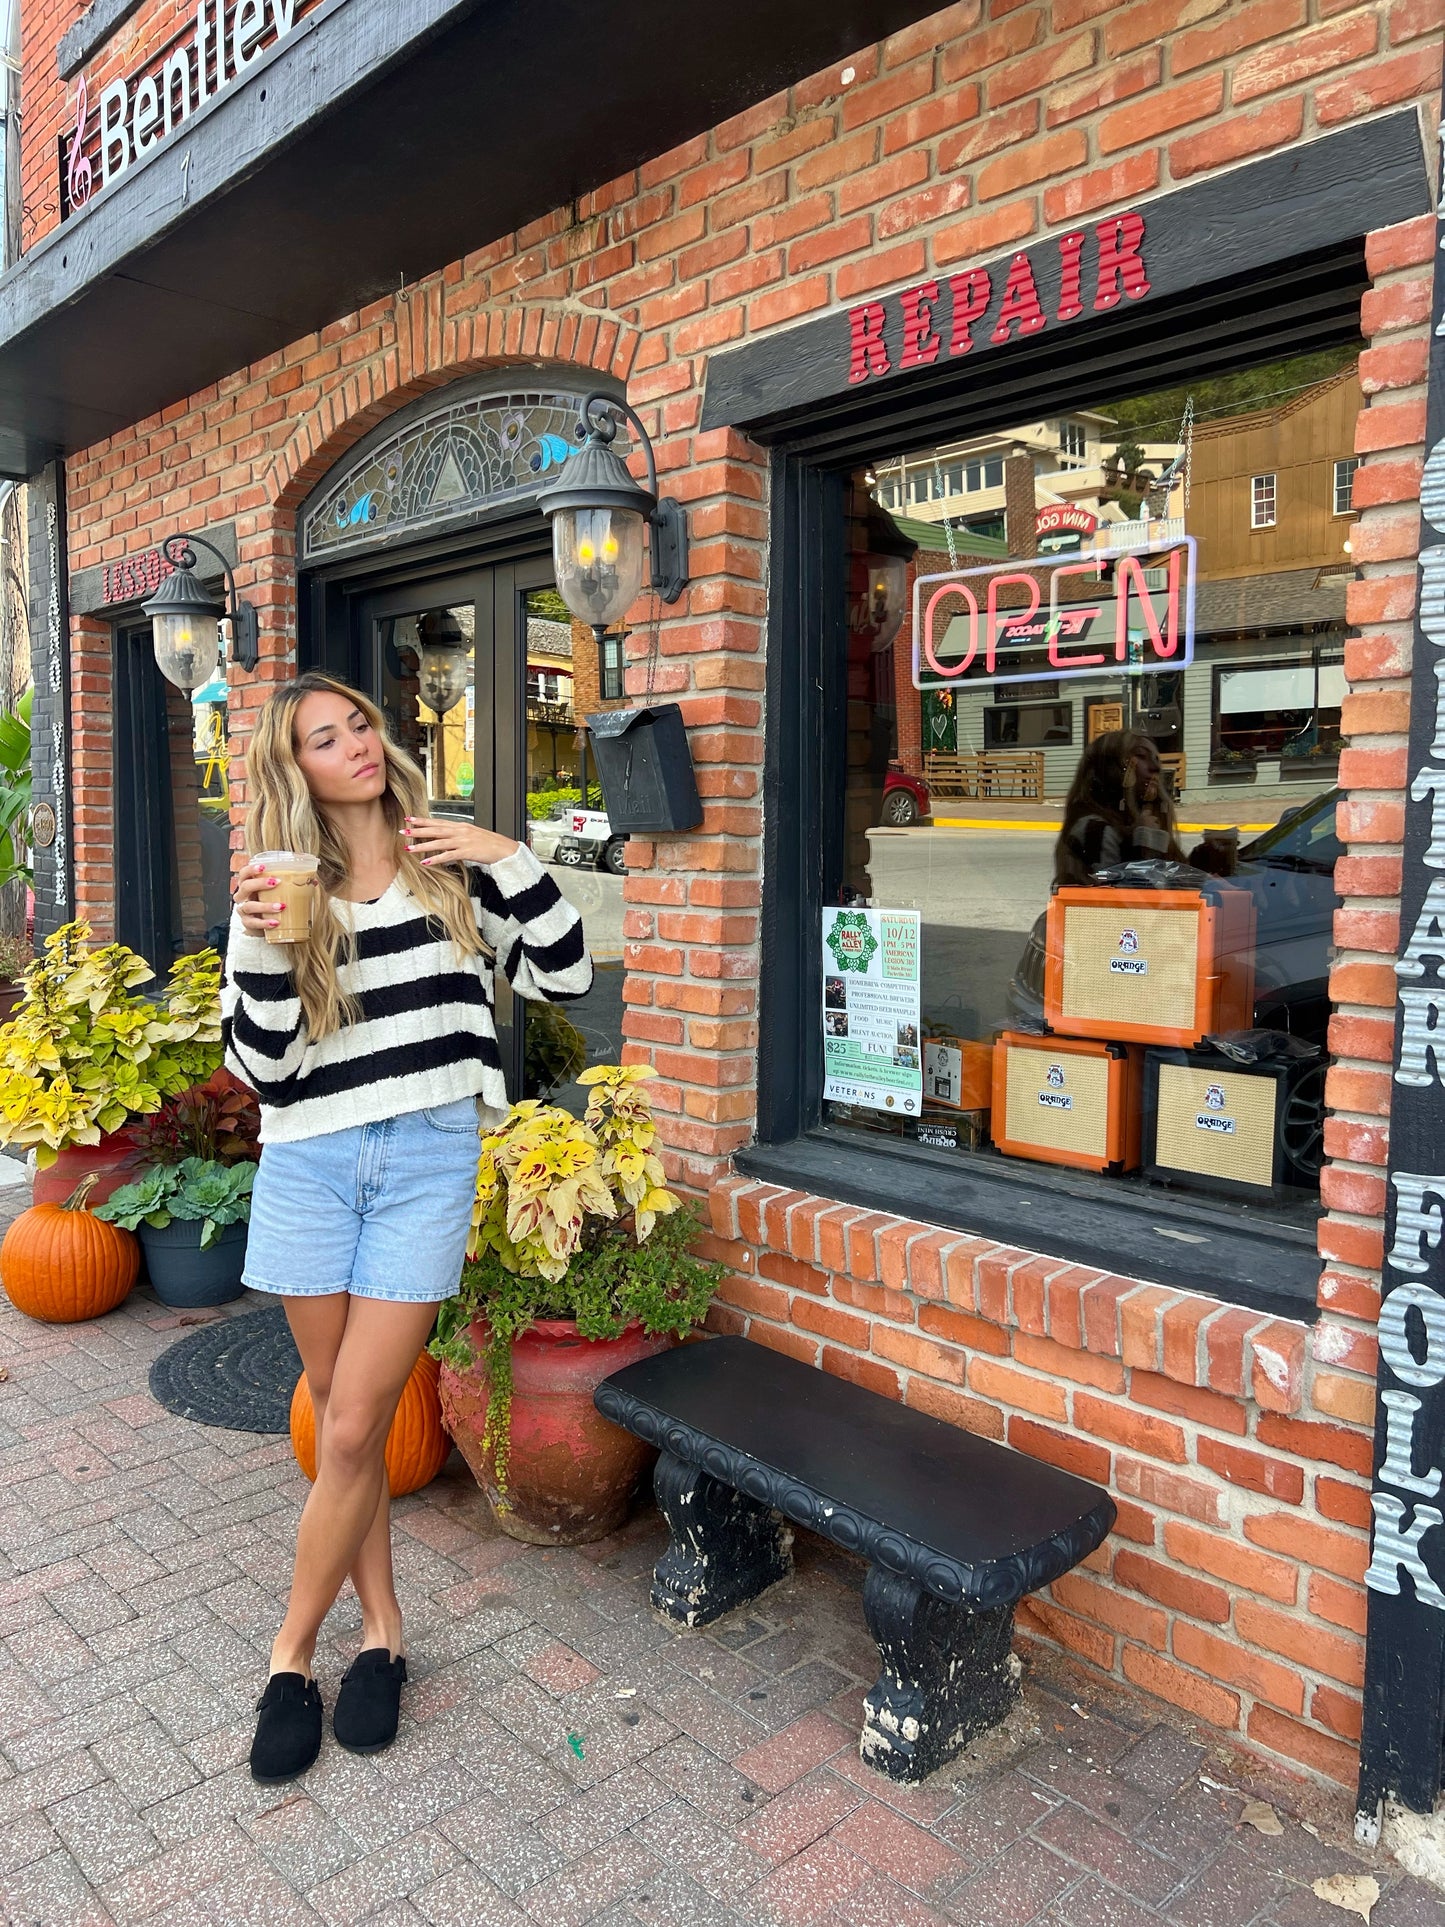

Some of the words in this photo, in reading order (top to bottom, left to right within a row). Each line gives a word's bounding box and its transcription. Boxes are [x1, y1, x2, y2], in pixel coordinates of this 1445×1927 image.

[848, 211, 1151, 385] REPAIR
[46, 502, 61, 692] PIANO
[924, 550, 1181, 677] OPEN
[52, 721, 66, 906] VOICE
[881, 915, 915, 924] SATURDAY
[841, 930, 862, 940] RALLY
[887, 926, 915, 941] 10/12
[842, 940, 862, 948] ALLEY
[886, 949, 914, 958] AMERICAN
[884, 957, 904, 965] LEGION
[1112, 961, 1145, 973] ORANGE
[849, 979, 879, 988] HOMEBREW
[880, 982, 916, 992] COMPETITION
[851, 991, 888, 1001] PROFESSIONAL
[889, 995, 915, 1004] BREWERS
[849, 1002, 878, 1012] UNLIMITED
[893, 1007, 916, 1016] SAMPLES
[854, 1015, 869, 1023] FOOD
[875, 1018, 893, 1026] MUSIC
[851, 1029, 870, 1037] SILENT
[870, 1031, 894, 1040] AUCTION
[827, 1041, 846, 1054] $25
[868, 1043, 887, 1054] FUN!
[829, 1085, 876, 1100] VETERANS
[1040, 1095, 1070, 1107] ORANGE
[1197, 1117, 1232, 1131] ORANGE
[1364, 1171, 1445, 1610] FOLK
